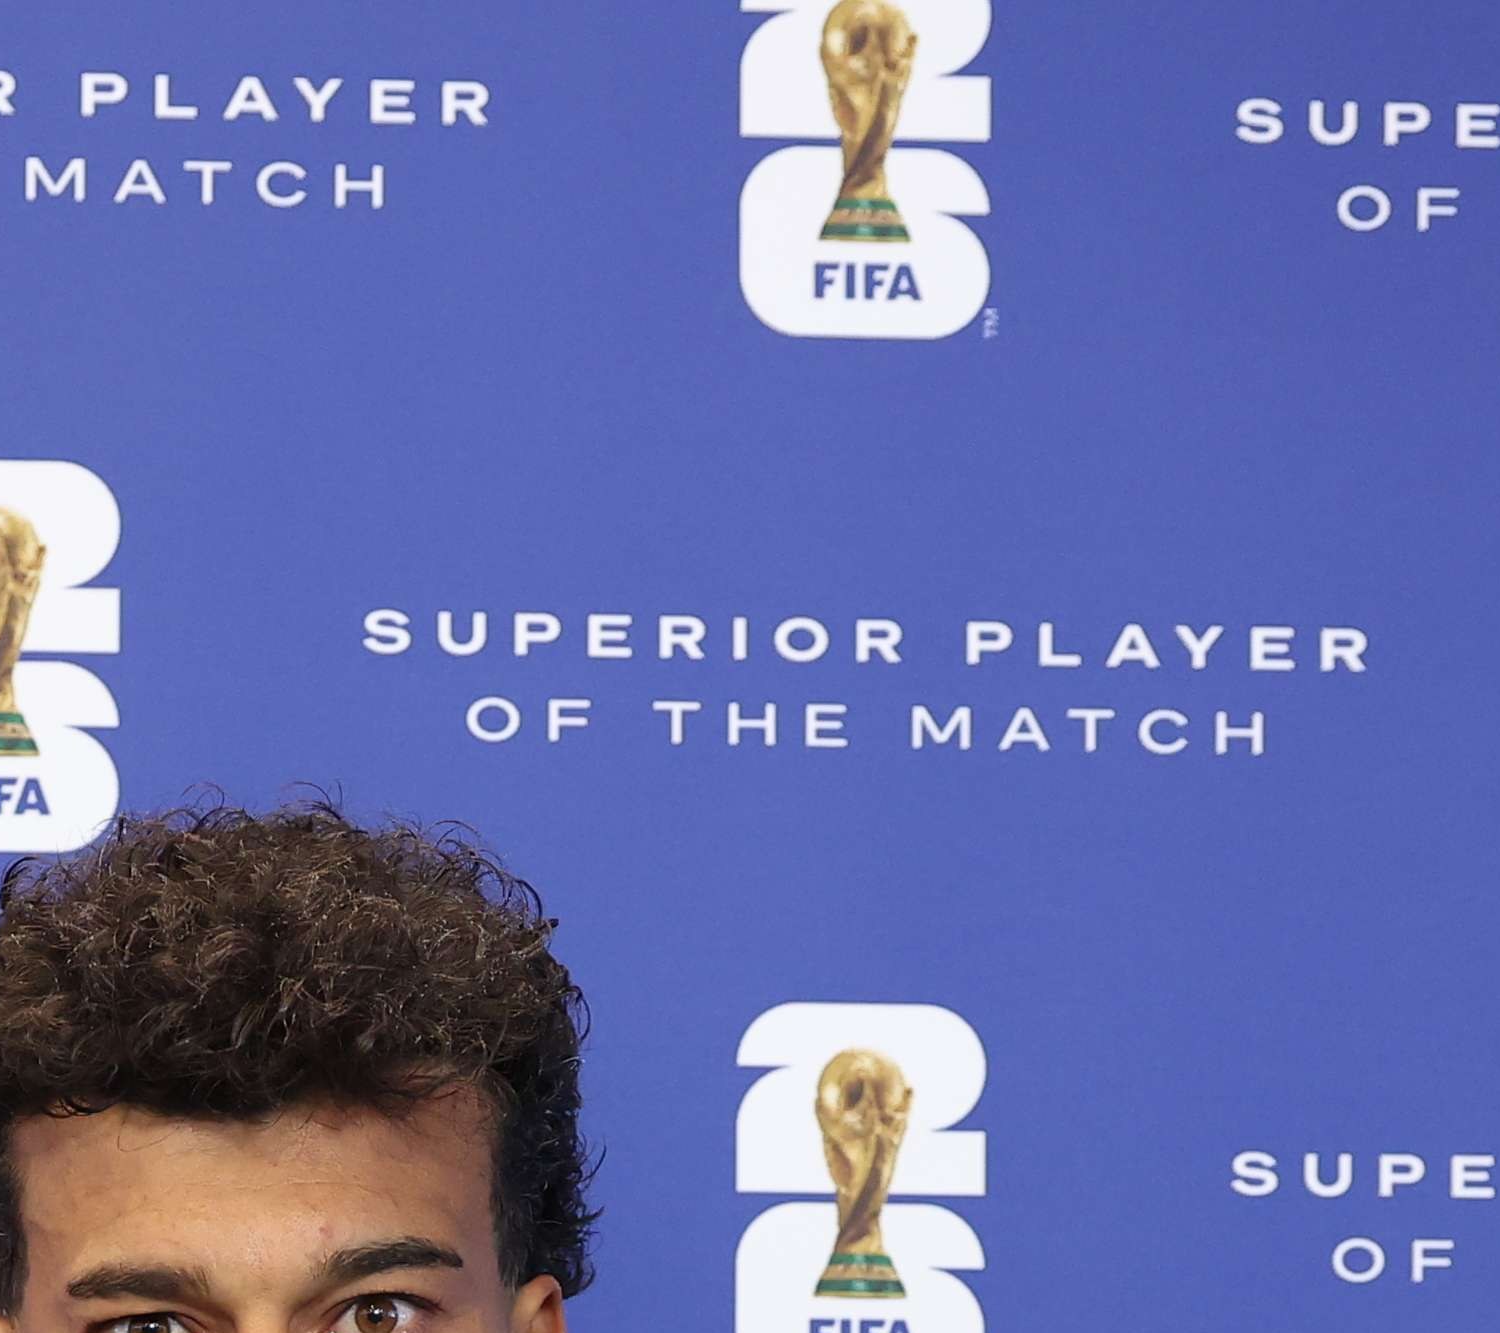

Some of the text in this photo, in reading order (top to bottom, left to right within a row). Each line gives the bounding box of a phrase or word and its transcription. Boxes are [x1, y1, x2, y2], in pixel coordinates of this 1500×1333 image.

[80, 71, 490, 127] PLAYER
[24, 156, 385, 210] MATCH
[1336, 184, 1461, 232] OF
[813, 261, 922, 301] FIFA
[362, 608, 1368, 674] SUPERIOR PLAYER
[465, 696, 1265, 756] OF THE MATCH
[1331, 1237, 1455, 1284] OF
